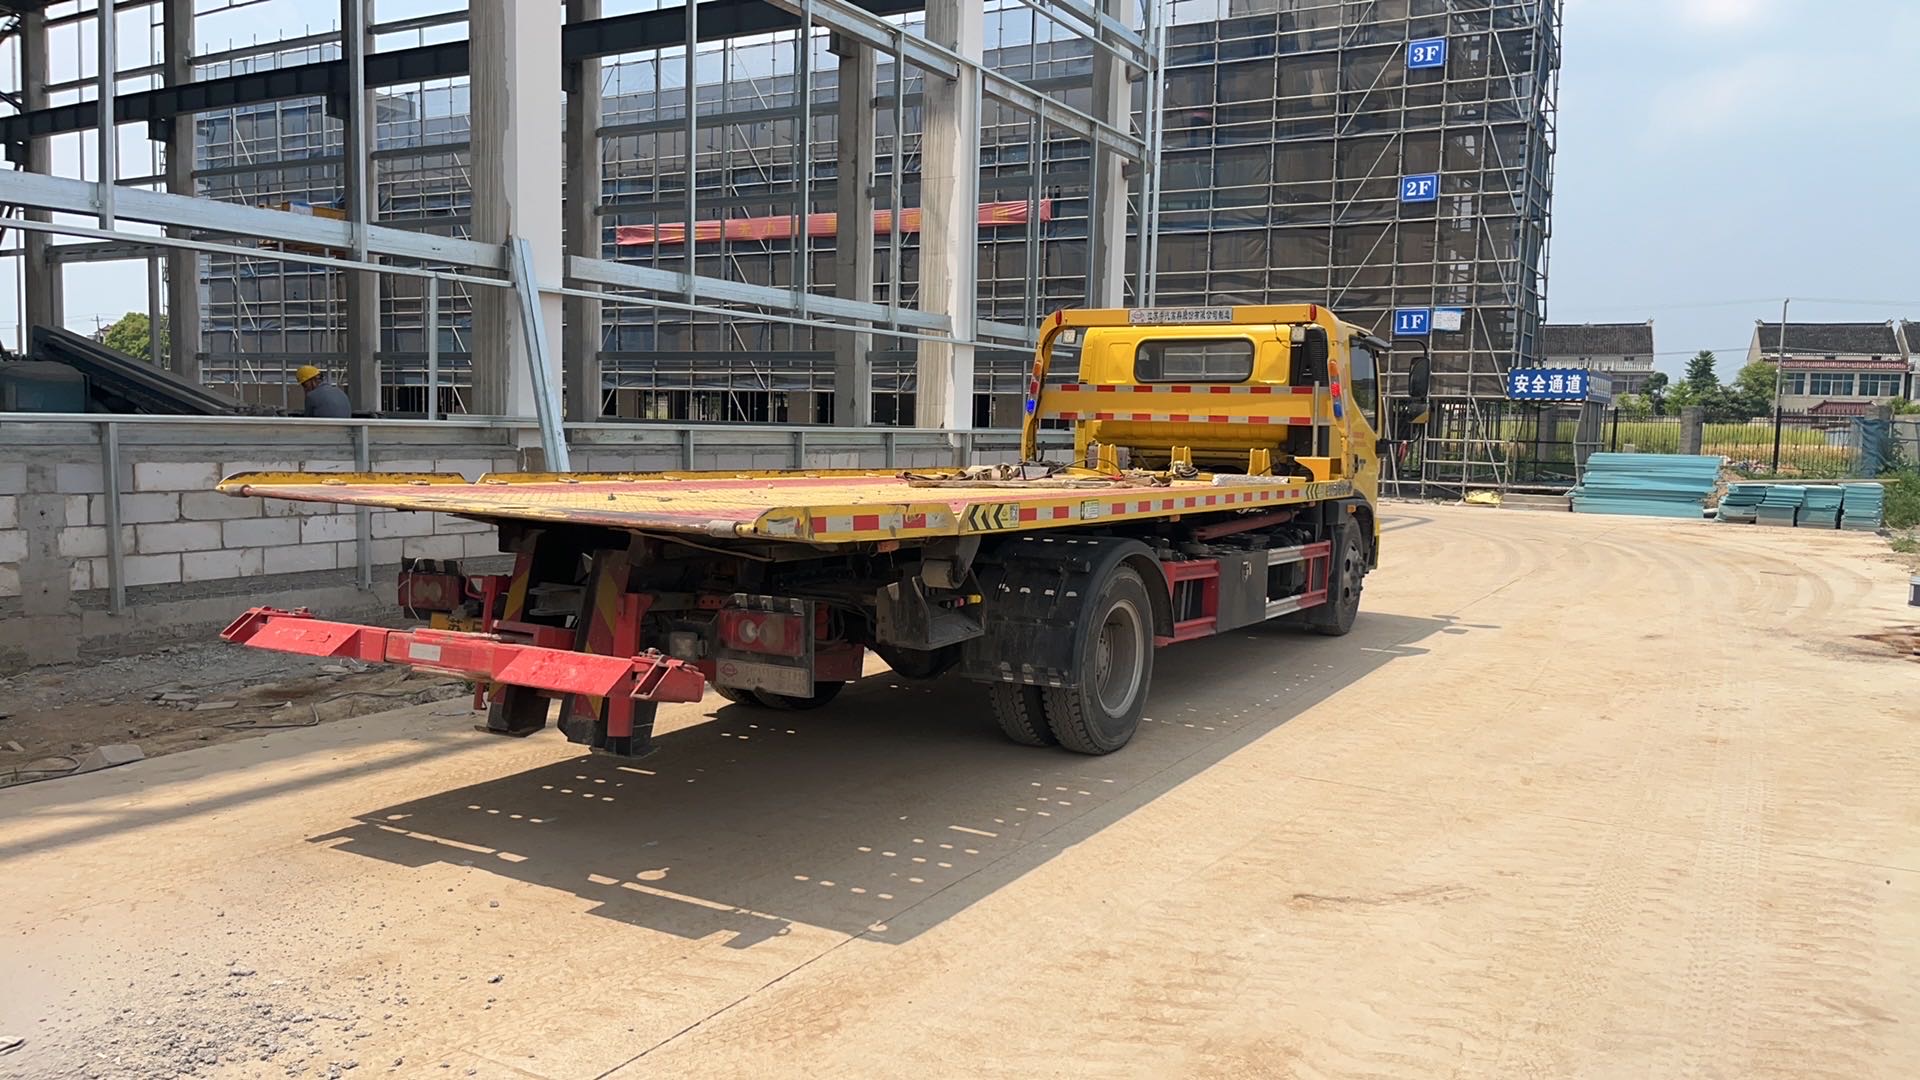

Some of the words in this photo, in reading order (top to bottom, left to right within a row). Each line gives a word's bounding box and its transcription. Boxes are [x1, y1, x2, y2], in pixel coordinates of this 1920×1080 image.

[1413, 46, 1439, 62] 3F
[1406, 180, 1431, 196] 2F
[1400, 314, 1424, 329] 1F
[1514, 373, 1582, 394] 安全通道
